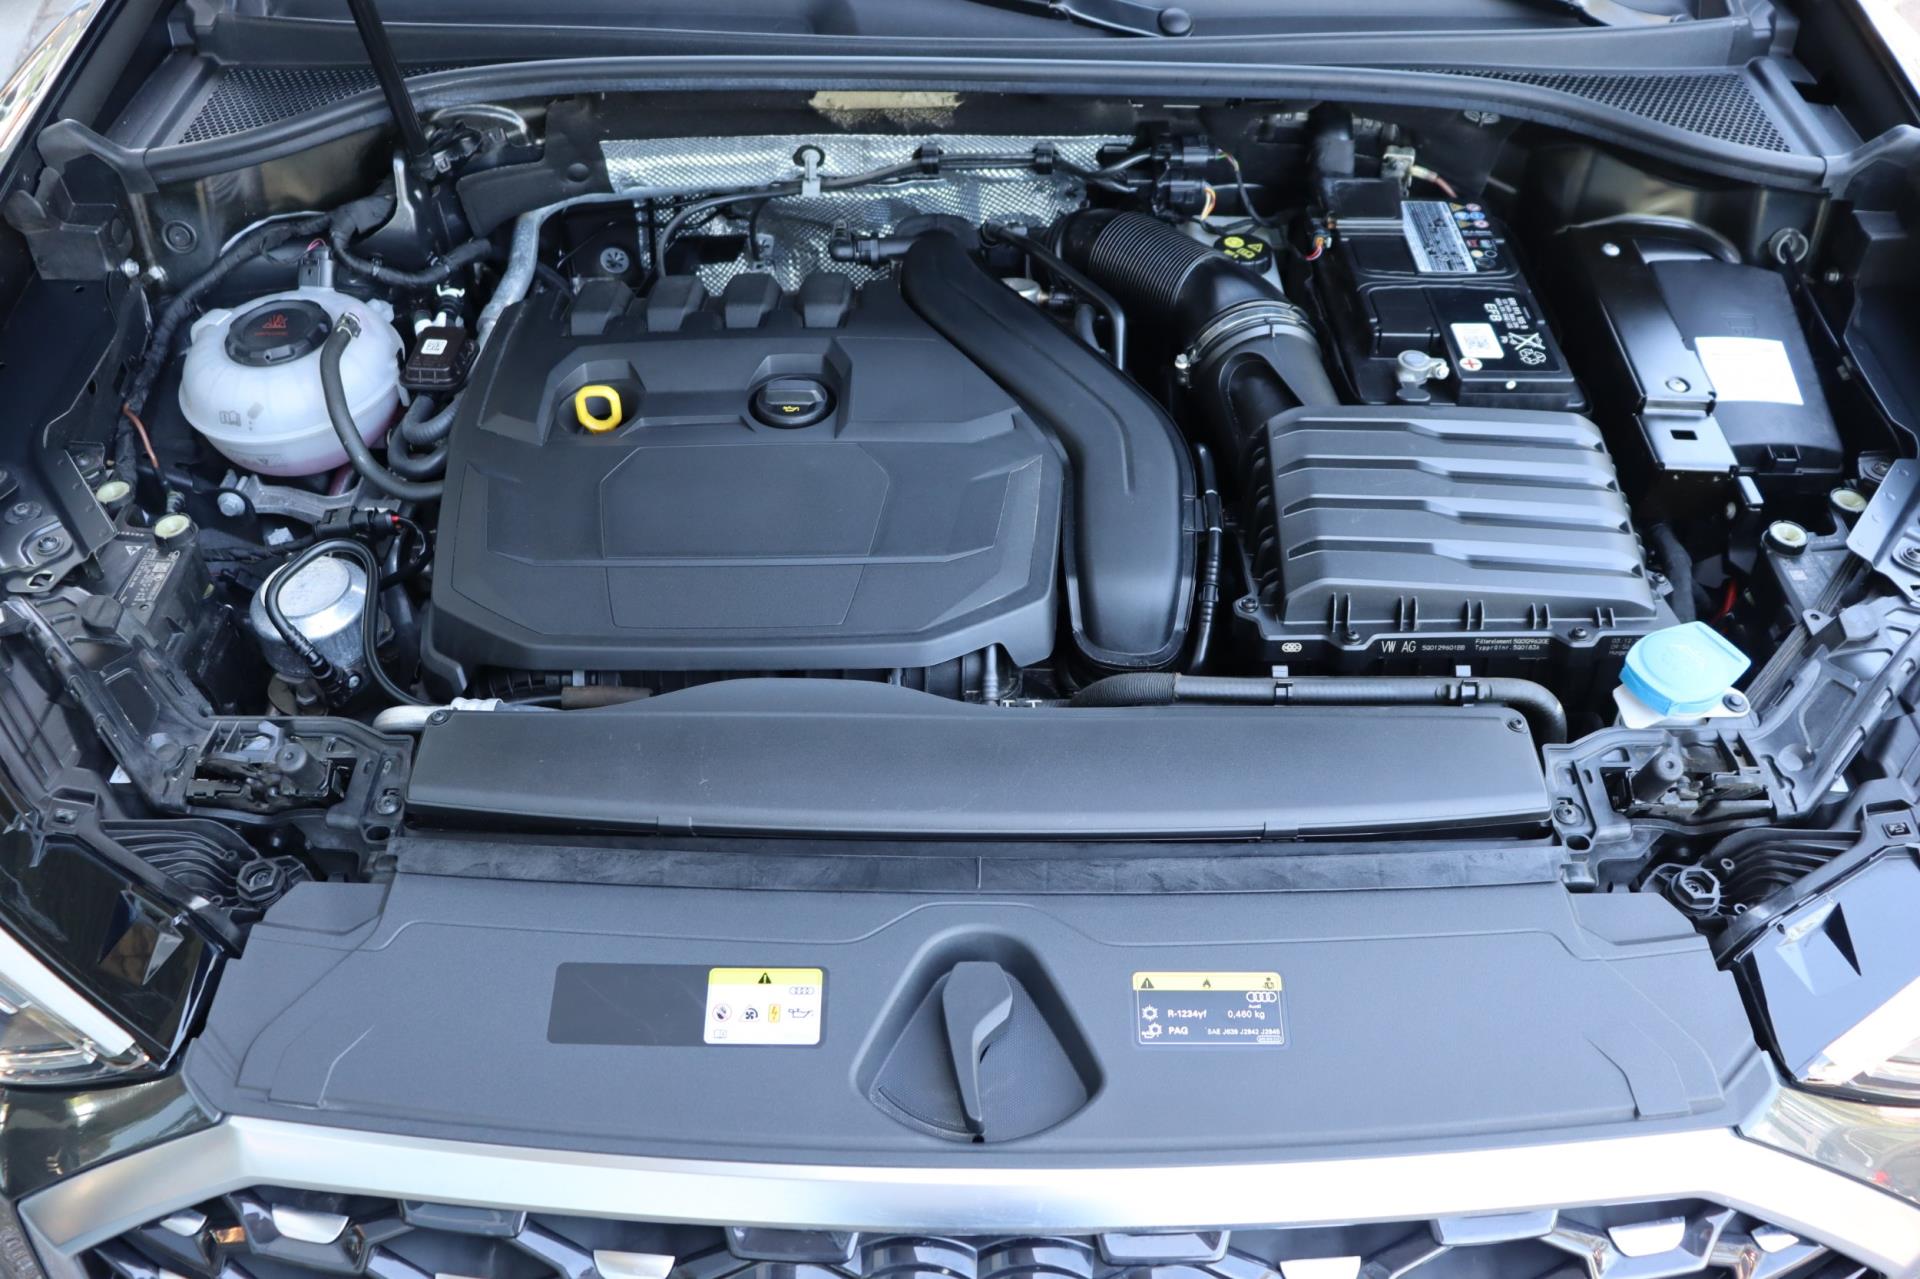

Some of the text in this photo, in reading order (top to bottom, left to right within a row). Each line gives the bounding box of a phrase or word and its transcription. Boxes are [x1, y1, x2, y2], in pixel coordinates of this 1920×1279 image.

[1381, 640, 1416, 653] VW AG
[1167, 1009, 1207, 1020] R-1234yf
[1254, 1009, 1265, 1020] kg
[1168, 1026, 1189, 1035] PAG
